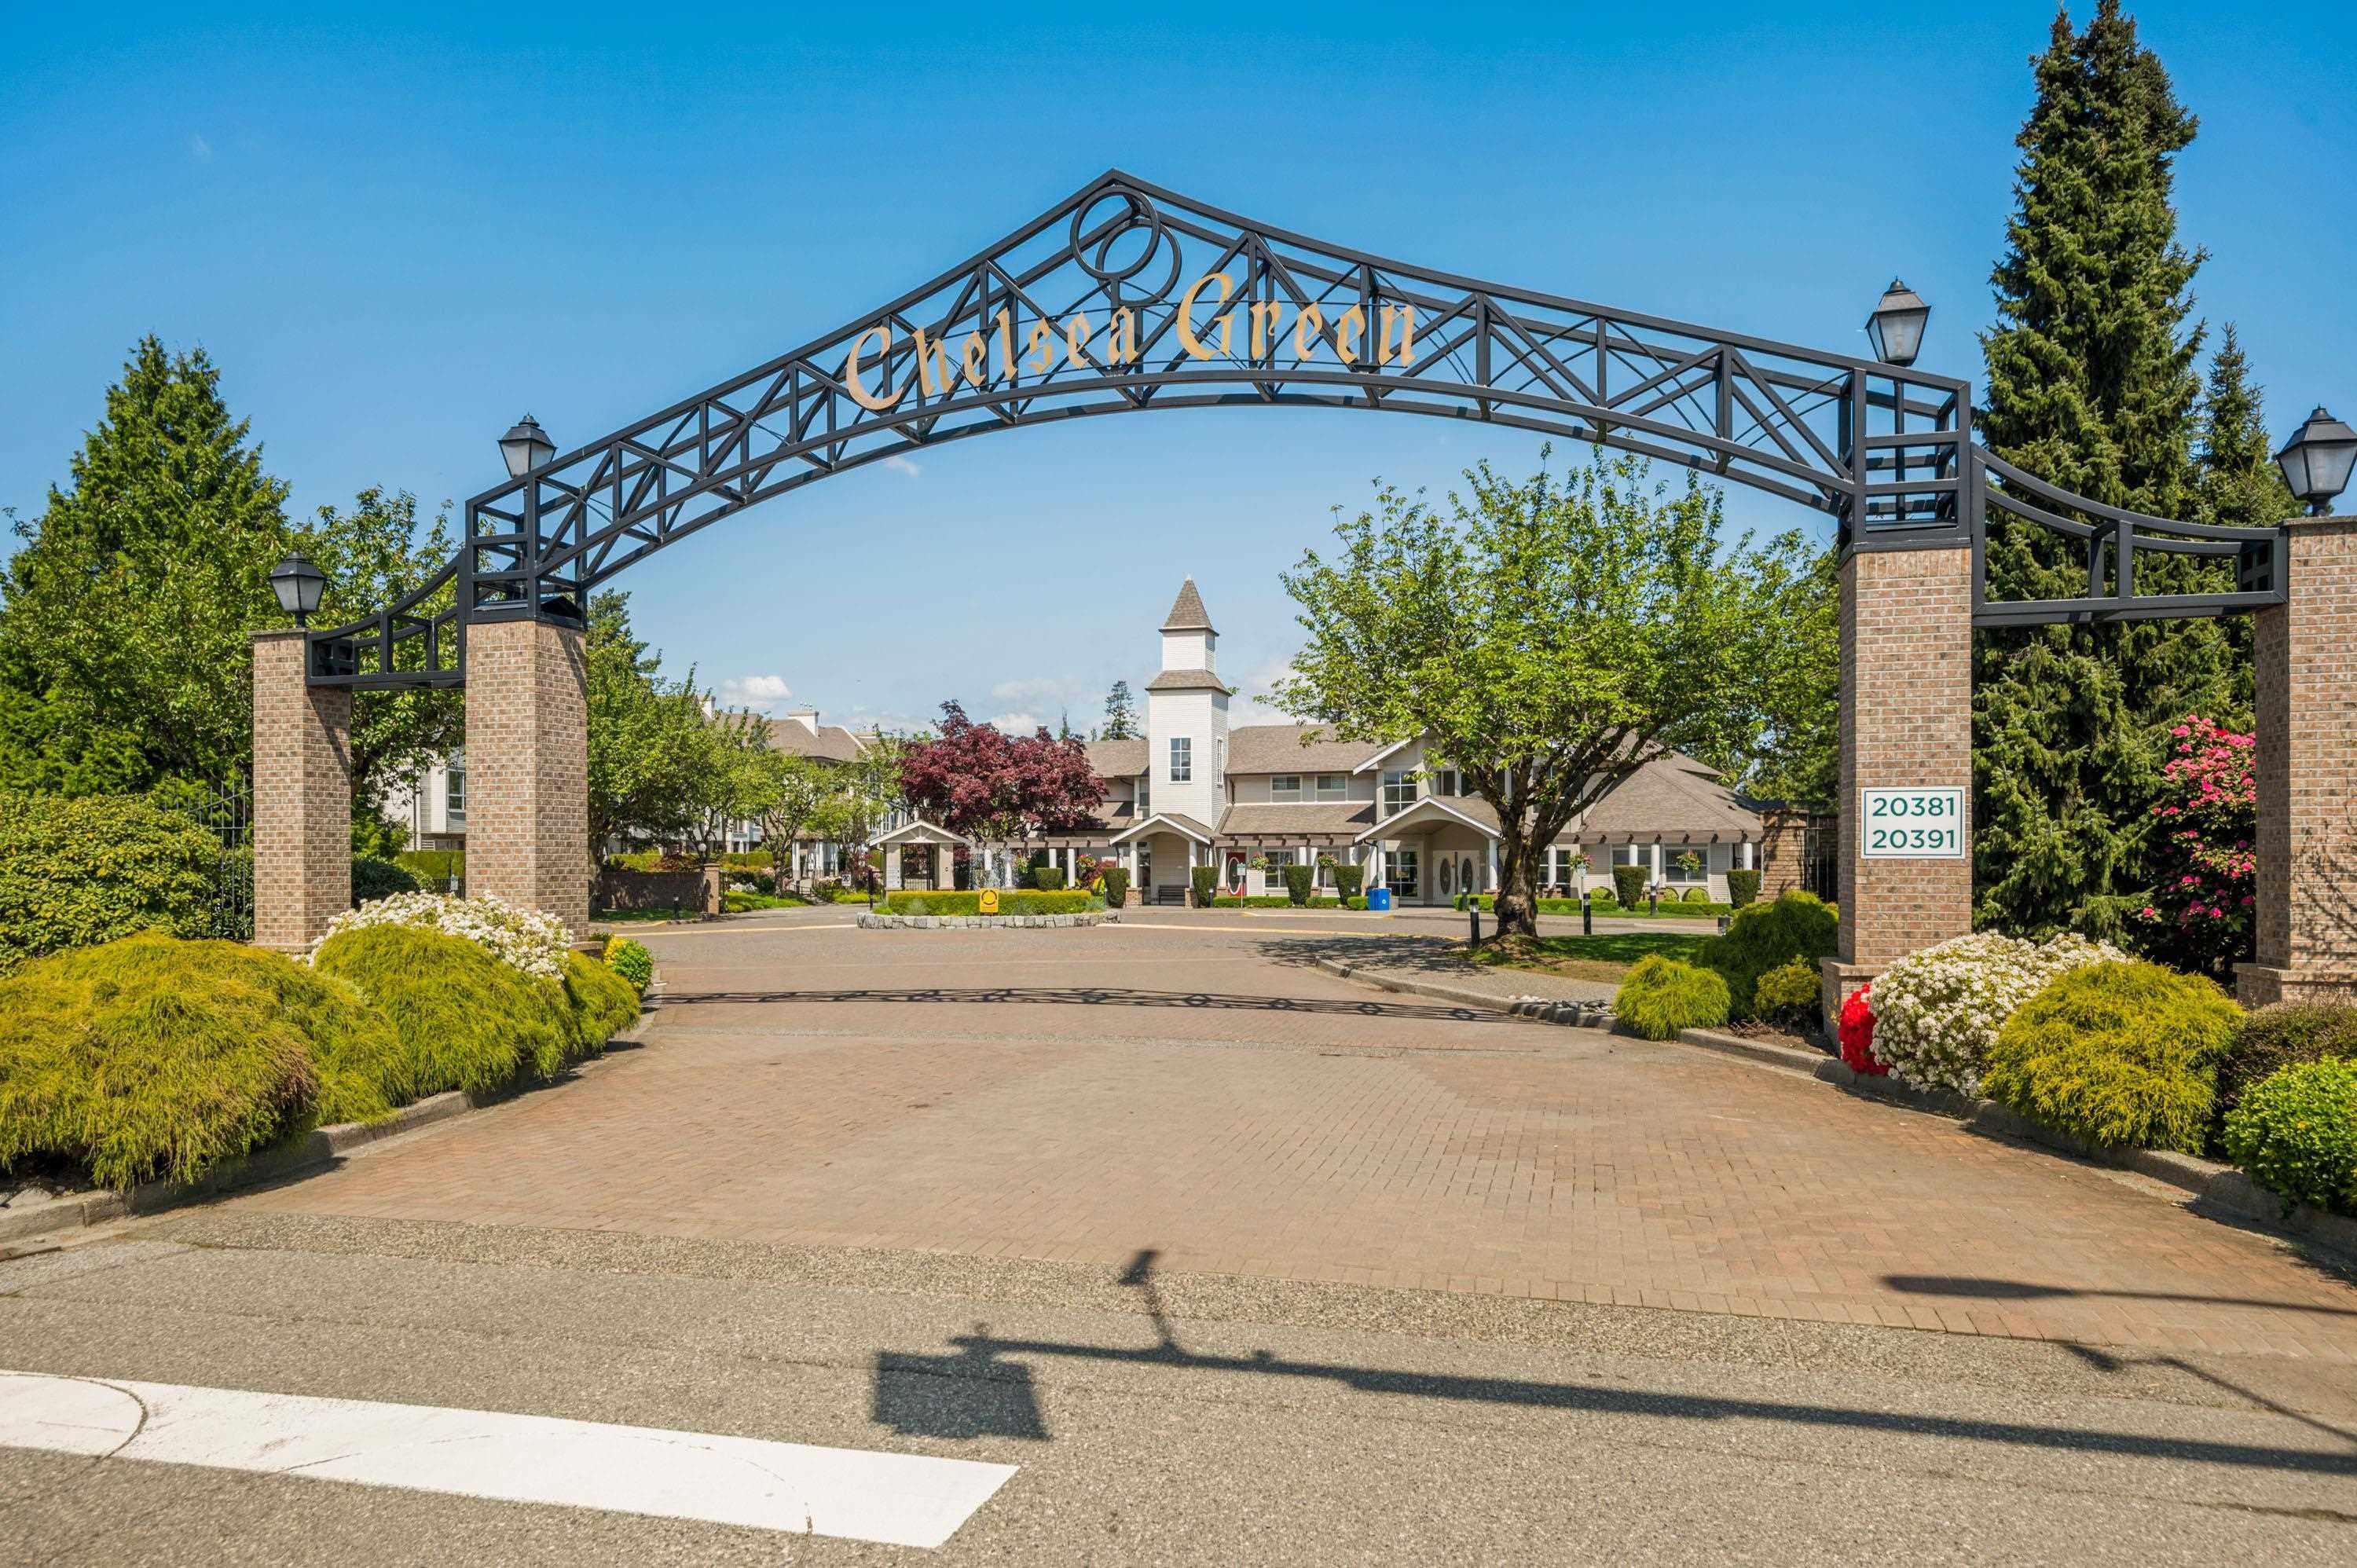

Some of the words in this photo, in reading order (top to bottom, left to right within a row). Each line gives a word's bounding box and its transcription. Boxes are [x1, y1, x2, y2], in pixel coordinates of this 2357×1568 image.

[845, 306, 1141, 410] Chelsea
[1177, 272, 1417, 368] Green
[1872, 797, 1955, 816] 20381
[1871, 829, 1955, 848] 20391
